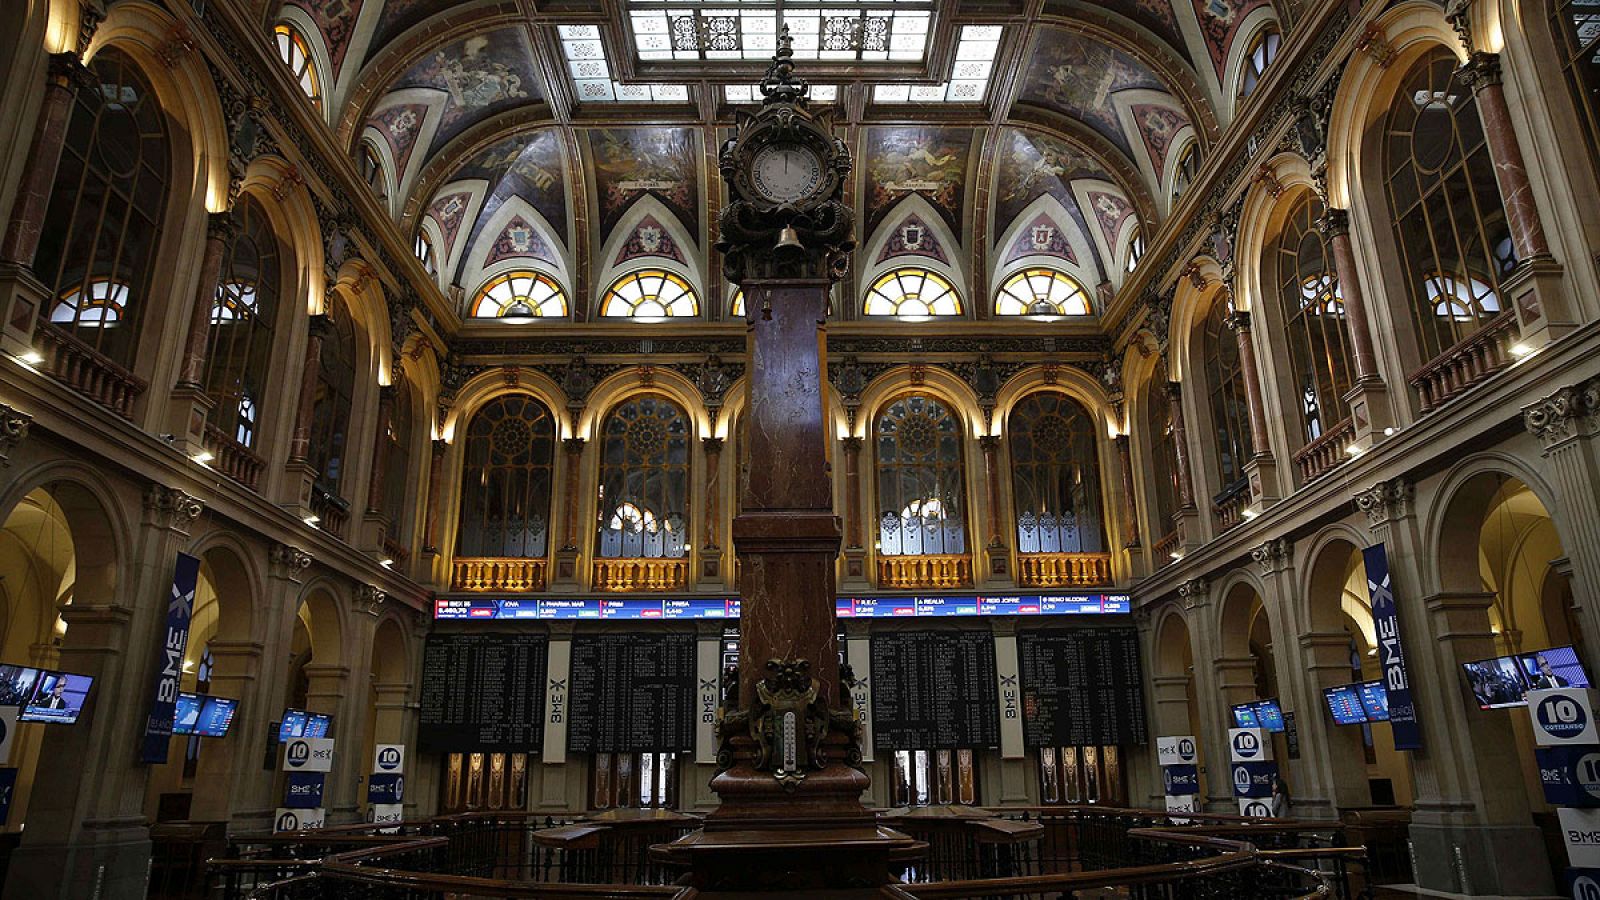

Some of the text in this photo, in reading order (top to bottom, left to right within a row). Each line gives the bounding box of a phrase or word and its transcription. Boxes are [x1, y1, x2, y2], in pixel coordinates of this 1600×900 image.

[1378, 616, 1405, 691] BME
[158, 626, 184, 703] BME
[551, 694, 562, 723] BME
[703, 694, 714, 722] BME
[1004, 690, 1016, 718] BME
[1545, 700, 1577, 723] 10
[1181, 742, 1191, 752] 10
[1238, 735, 1255, 748] 10
[291, 744, 306, 758] 10
[383, 752, 397, 762] 10
[1541, 769, 1560, 780] BME
[1249, 805, 1267, 816] 10
[281, 816, 294, 830] 10
